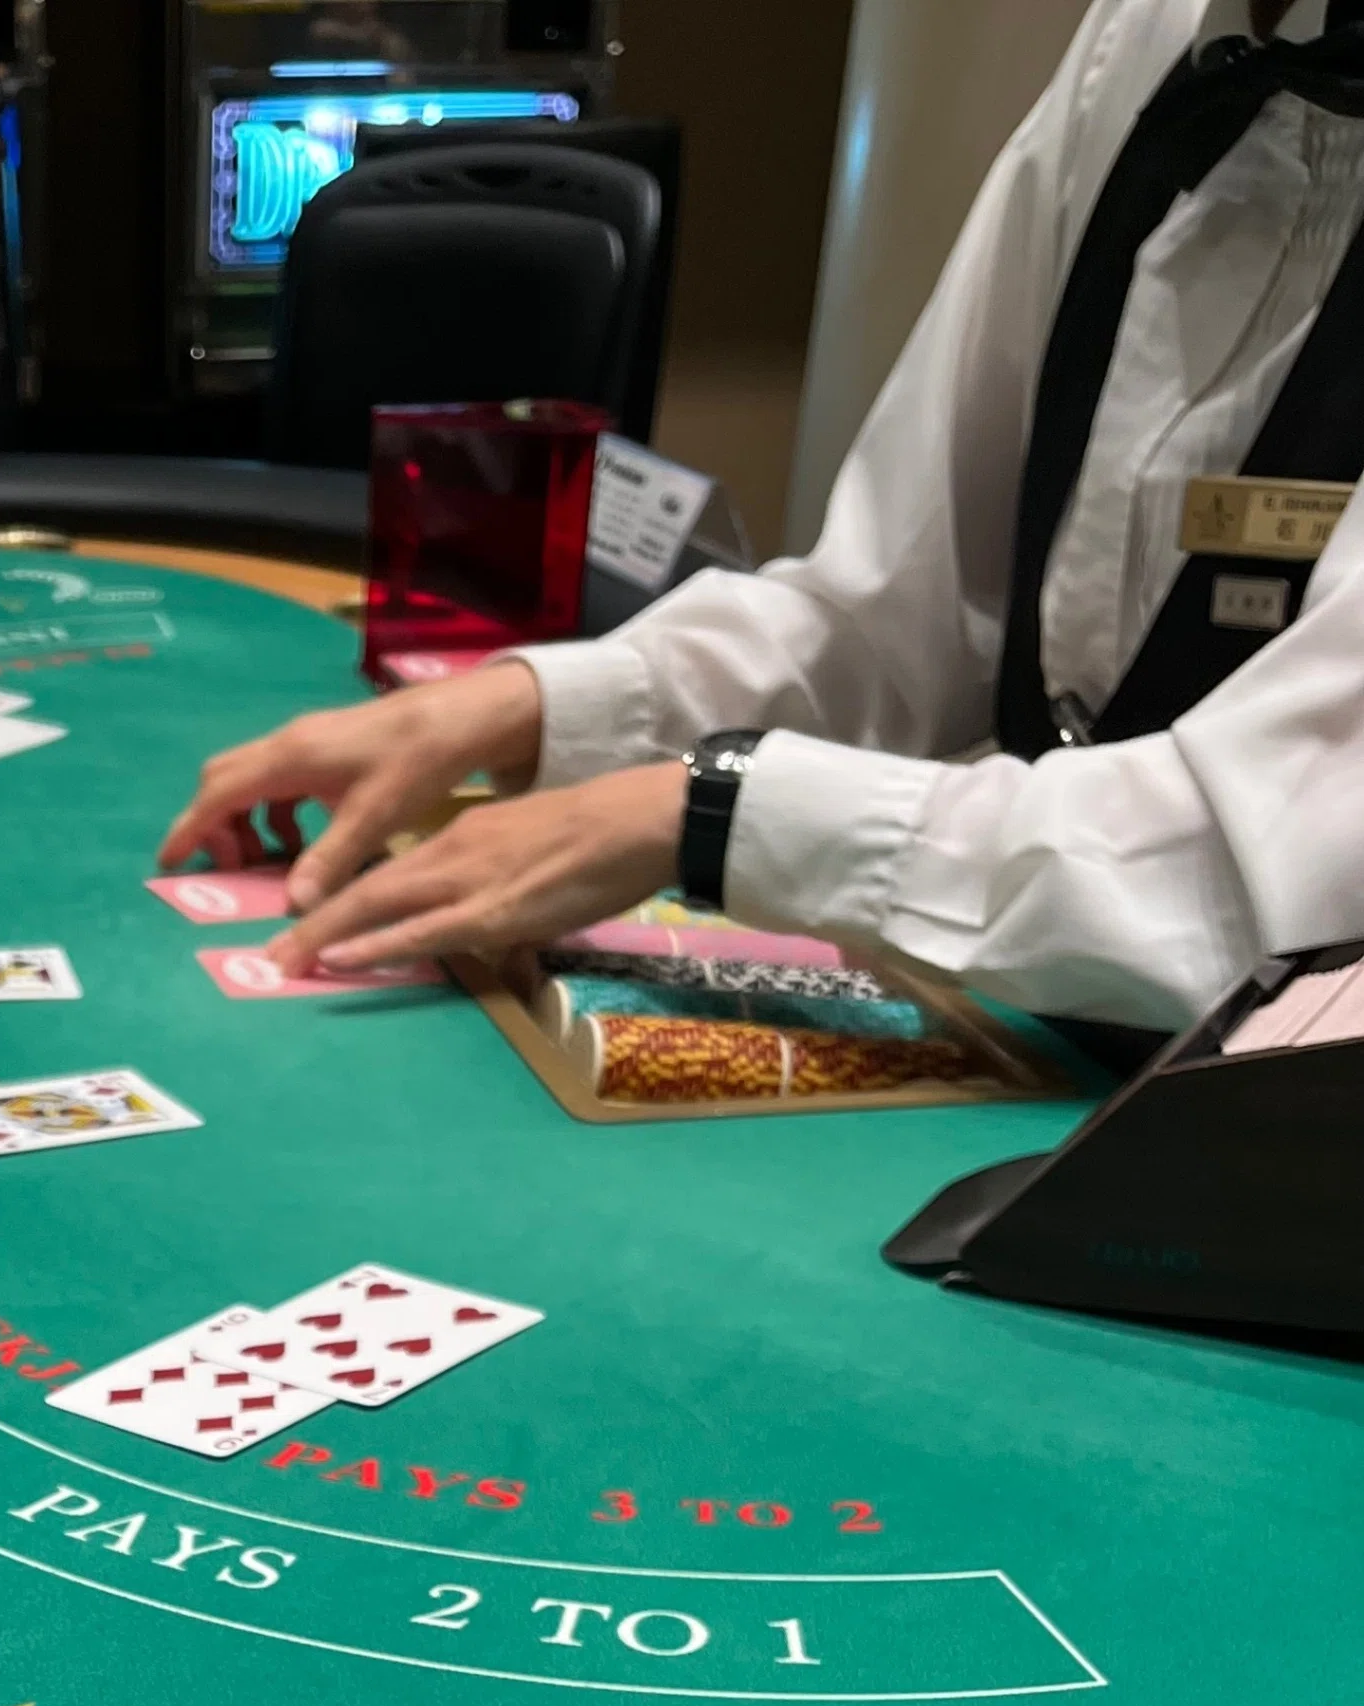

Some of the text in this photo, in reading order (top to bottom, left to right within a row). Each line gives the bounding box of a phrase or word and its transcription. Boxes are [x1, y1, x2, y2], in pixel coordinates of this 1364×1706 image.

[262, 1441, 527, 1511] PAYS
[591, 1490, 638, 1523] 3
[681, 1496, 795, 1529] TO
[831, 1500, 883, 1533] 2
[7, 1484, 298, 1590] PAYS
[410, 1584, 481, 1630] 2
[530, 1597, 712, 1657] TO
[767, 1618, 821, 1665] 1
